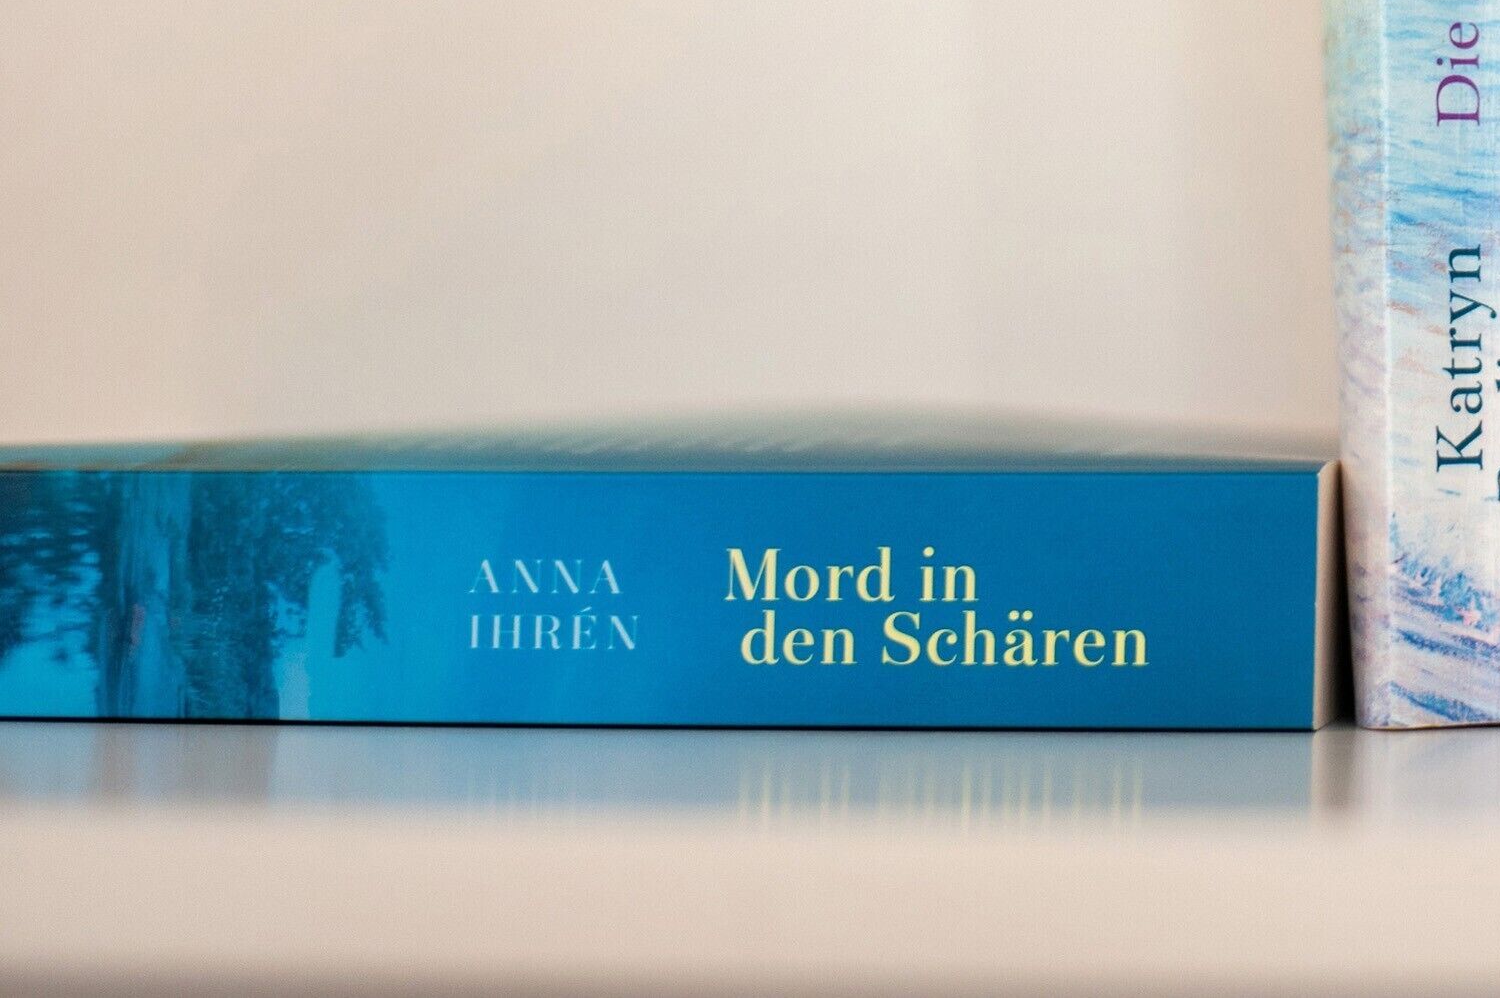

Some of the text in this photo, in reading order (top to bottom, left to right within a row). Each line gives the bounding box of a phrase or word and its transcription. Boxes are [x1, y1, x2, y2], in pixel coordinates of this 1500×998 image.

[1436, 20, 1481, 127] Die
[1436, 243, 1498, 472] Katryn
[467, 557, 623, 596] ANNA
[724, 546, 979, 602] Mord in
[468, 605, 640, 651] IHRÉN
[740, 609, 1150, 668] den Schären
